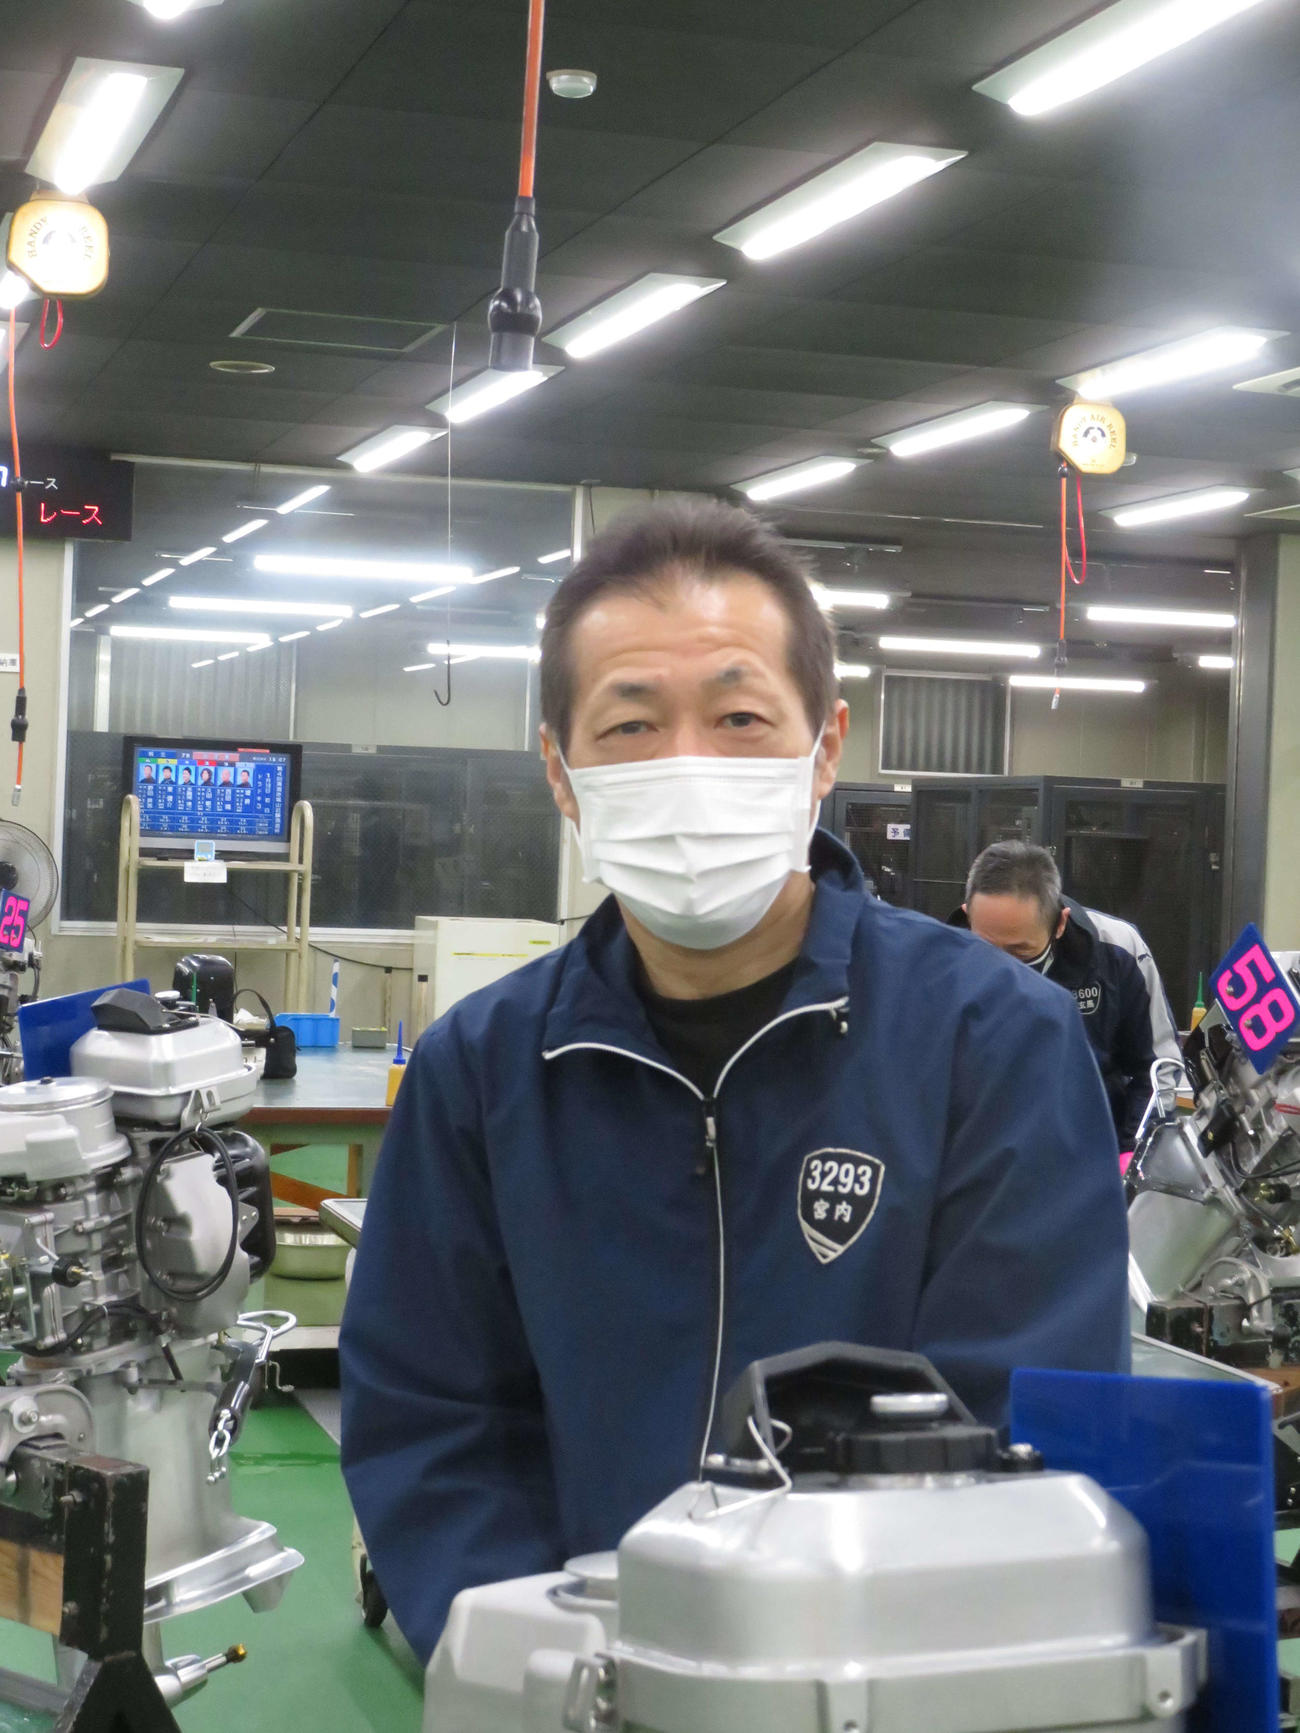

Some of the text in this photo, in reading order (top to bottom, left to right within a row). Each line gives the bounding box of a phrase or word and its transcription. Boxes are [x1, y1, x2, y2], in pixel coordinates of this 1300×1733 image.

[39, 502, 104, 526] レース
[0, 895, 30, 949] 25
[1216, 943, 1296, 1052] 58
[806, 1159, 873, 1197] 3293
[812, 1198, 853, 1223] 宮内
